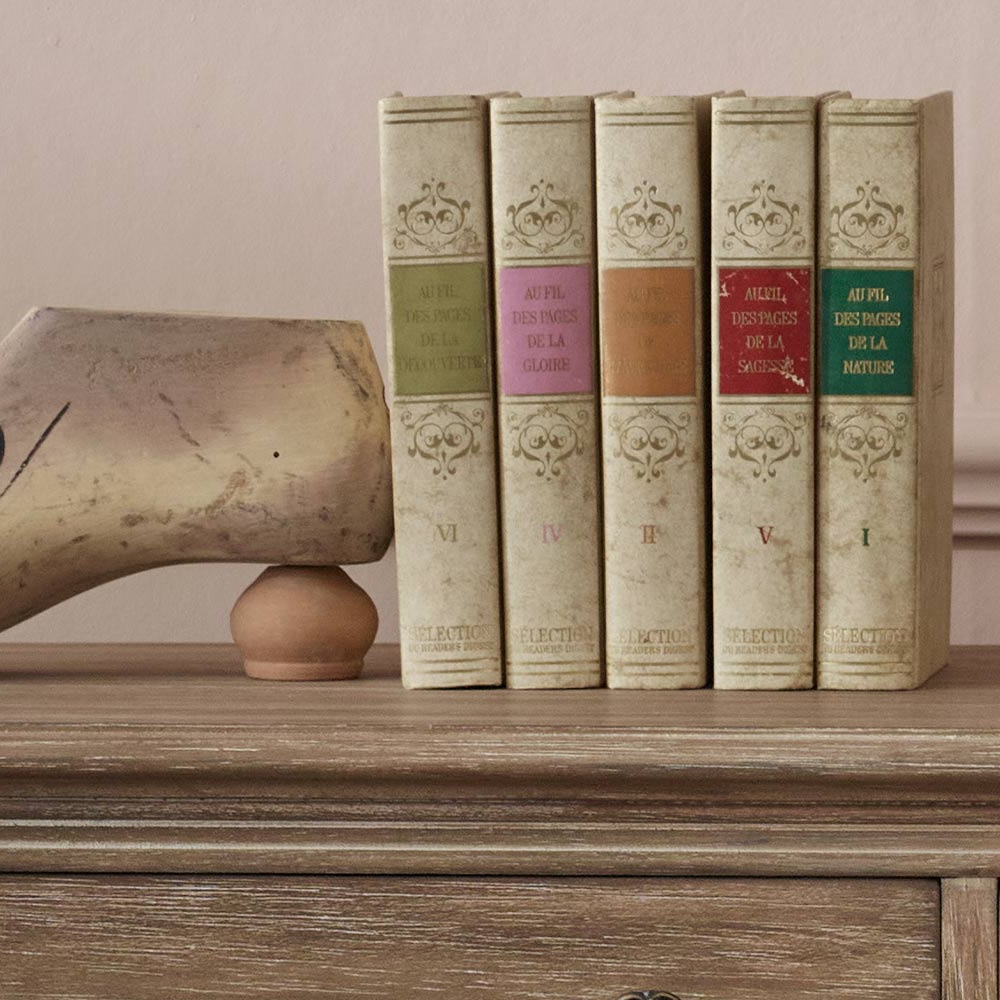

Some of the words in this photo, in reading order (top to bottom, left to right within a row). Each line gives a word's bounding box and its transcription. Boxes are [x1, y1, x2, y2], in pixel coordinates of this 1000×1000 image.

[525, 286, 542, 301] AU
[544, 285, 566, 300] FIL
[846, 287, 864, 302] AU
[866, 287, 889, 302] FIL
[512, 310, 537, 325] DES
[540, 309, 578, 324] PAGES
[731, 311, 757, 326] DES
[759, 311, 798, 326] PAGES
[834, 311, 860, 326] DES
[861, 312, 901, 326] PAGES
[527, 334, 545, 349] DE
[548, 333, 566, 348] LA
[745, 335, 765, 350] DE
[767, 335, 786, 350] LA
[848, 335, 867, 350] DE
[869, 335, 888, 350] LA
[523, 357, 570, 373] GLOIRE
[737, 359, 795, 374] SAGESSE
[842, 360, 895, 375] NATURE
[542, 523, 562, 544] IV
[756, 525, 774, 545] V
[860, 526, 870, 547] I
